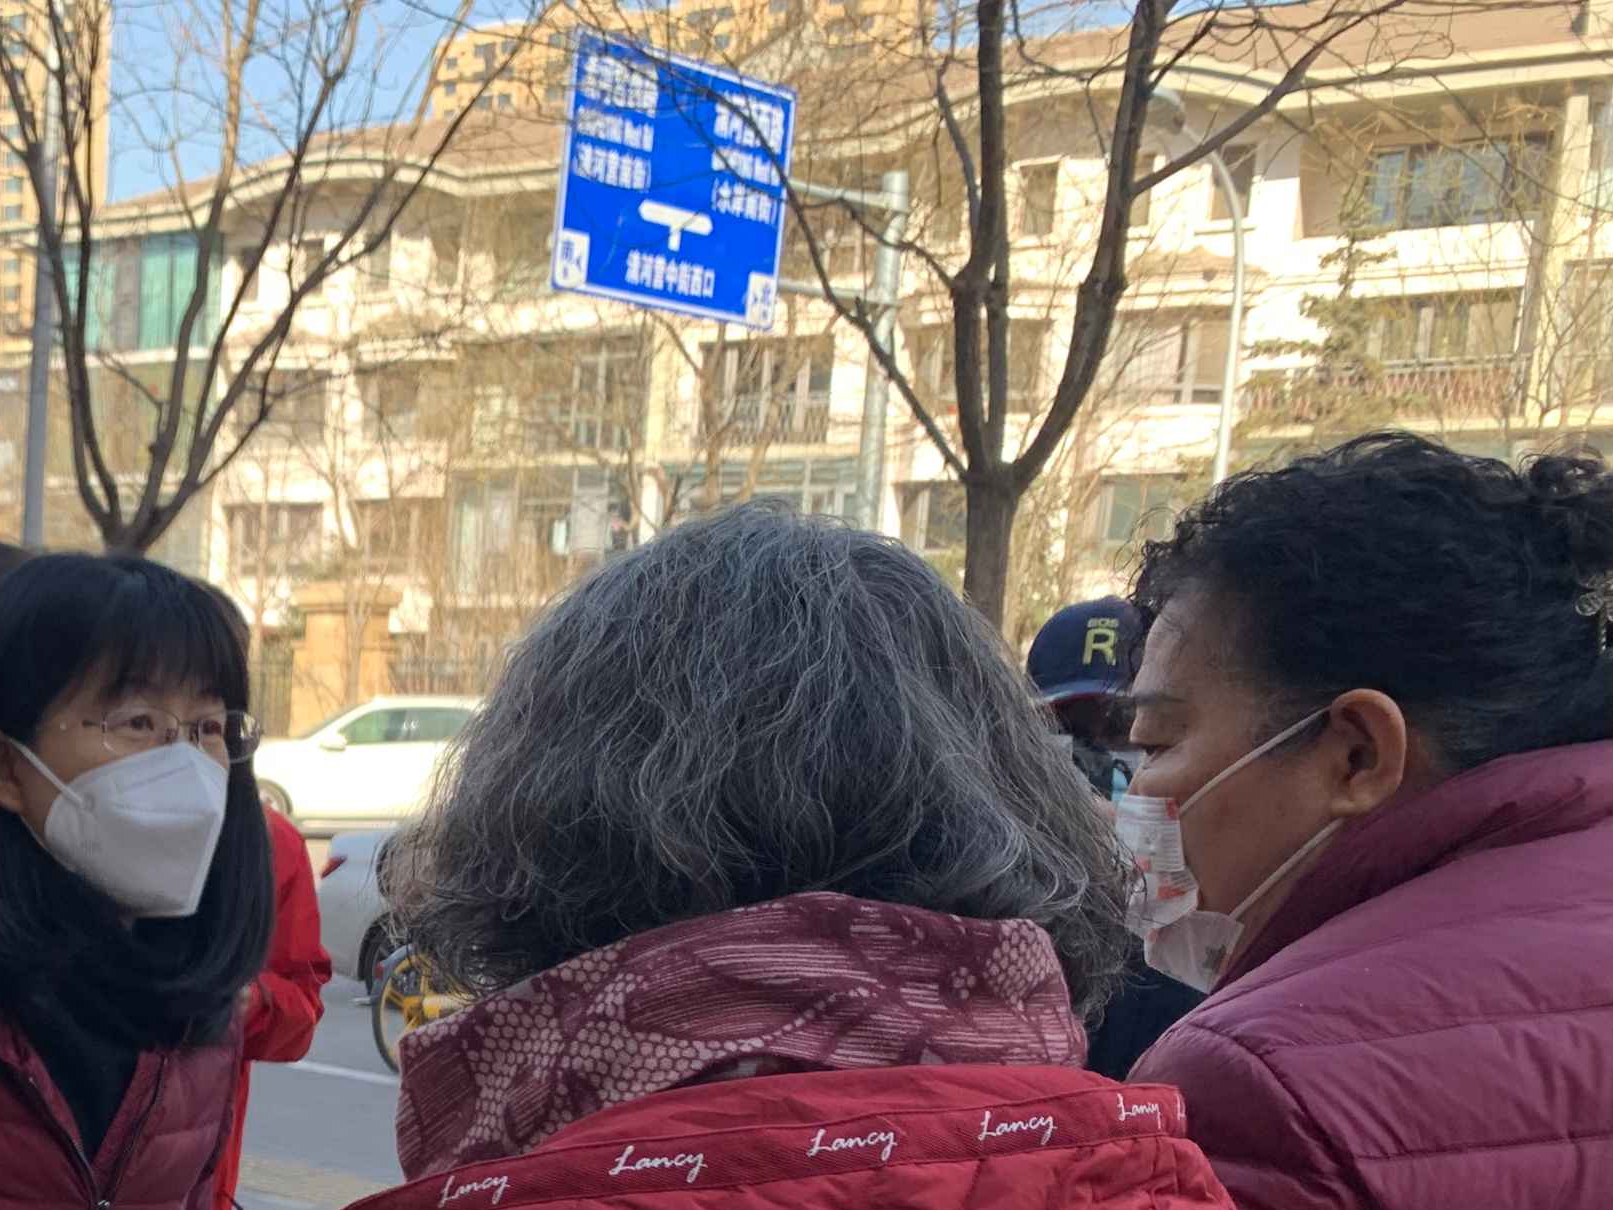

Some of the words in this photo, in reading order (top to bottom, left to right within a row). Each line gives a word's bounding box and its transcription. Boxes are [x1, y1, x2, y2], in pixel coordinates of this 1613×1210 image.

[1083, 629, 1117, 666] R
[805, 1117, 898, 1162] Lancy
[977, 1109, 1057, 1143] Lancy
[609, 1145, 709, 1183] Lancy
[439, 1174, 511, 1208] Lancy
